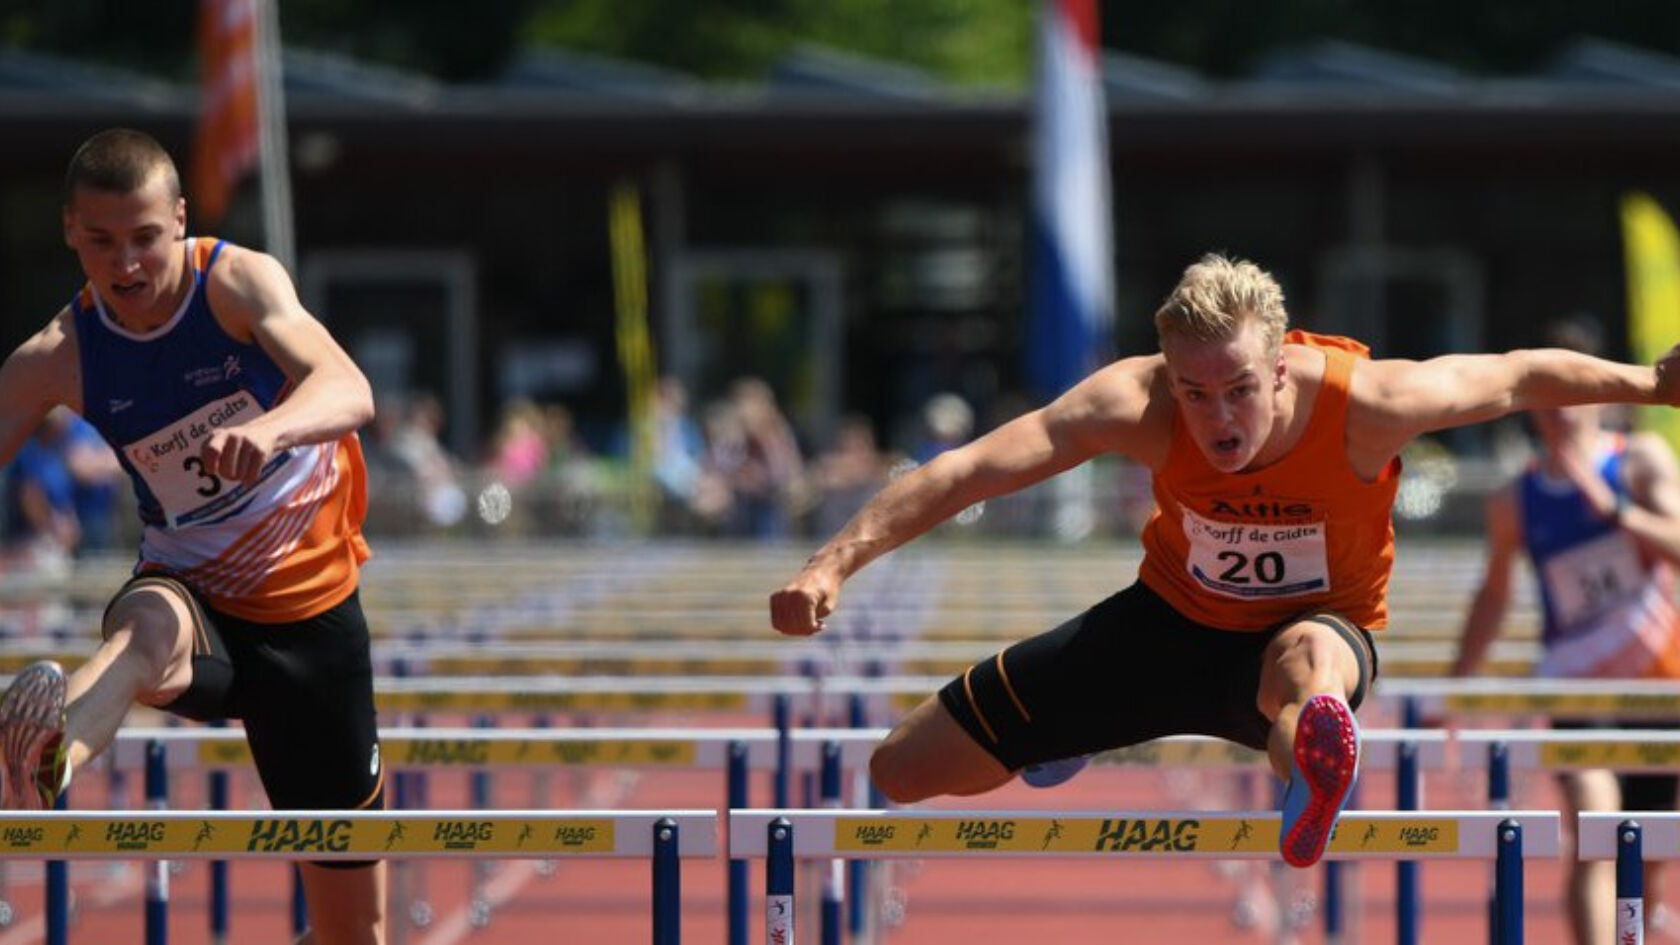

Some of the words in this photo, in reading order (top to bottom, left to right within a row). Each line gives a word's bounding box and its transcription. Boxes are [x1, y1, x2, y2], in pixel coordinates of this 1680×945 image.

[150, 432, 189, 457] Korff
[190, 424, 208, 439] de
[208, 398, 249, 427] Gidts
[1249, 529, 1269, 542] de
[1273, 527, 1318, 541] Gidts
[1217, 551, 1285, 584] 20
[3, 828, 43, 841] HAAG
[106, 822, 165, 841] HAAG
[247, 819, 353, 852] HAAG
[433, 821, 494, 841] HAAG
[555, 827, 596, 841] HAAG
[855, 826, 895, 839] HAAG
[955, 821, 1015, 840] HAAG
[1095, 819, 1199, 851] HAAG
[1399, 827, 1439, 841] HAAG
